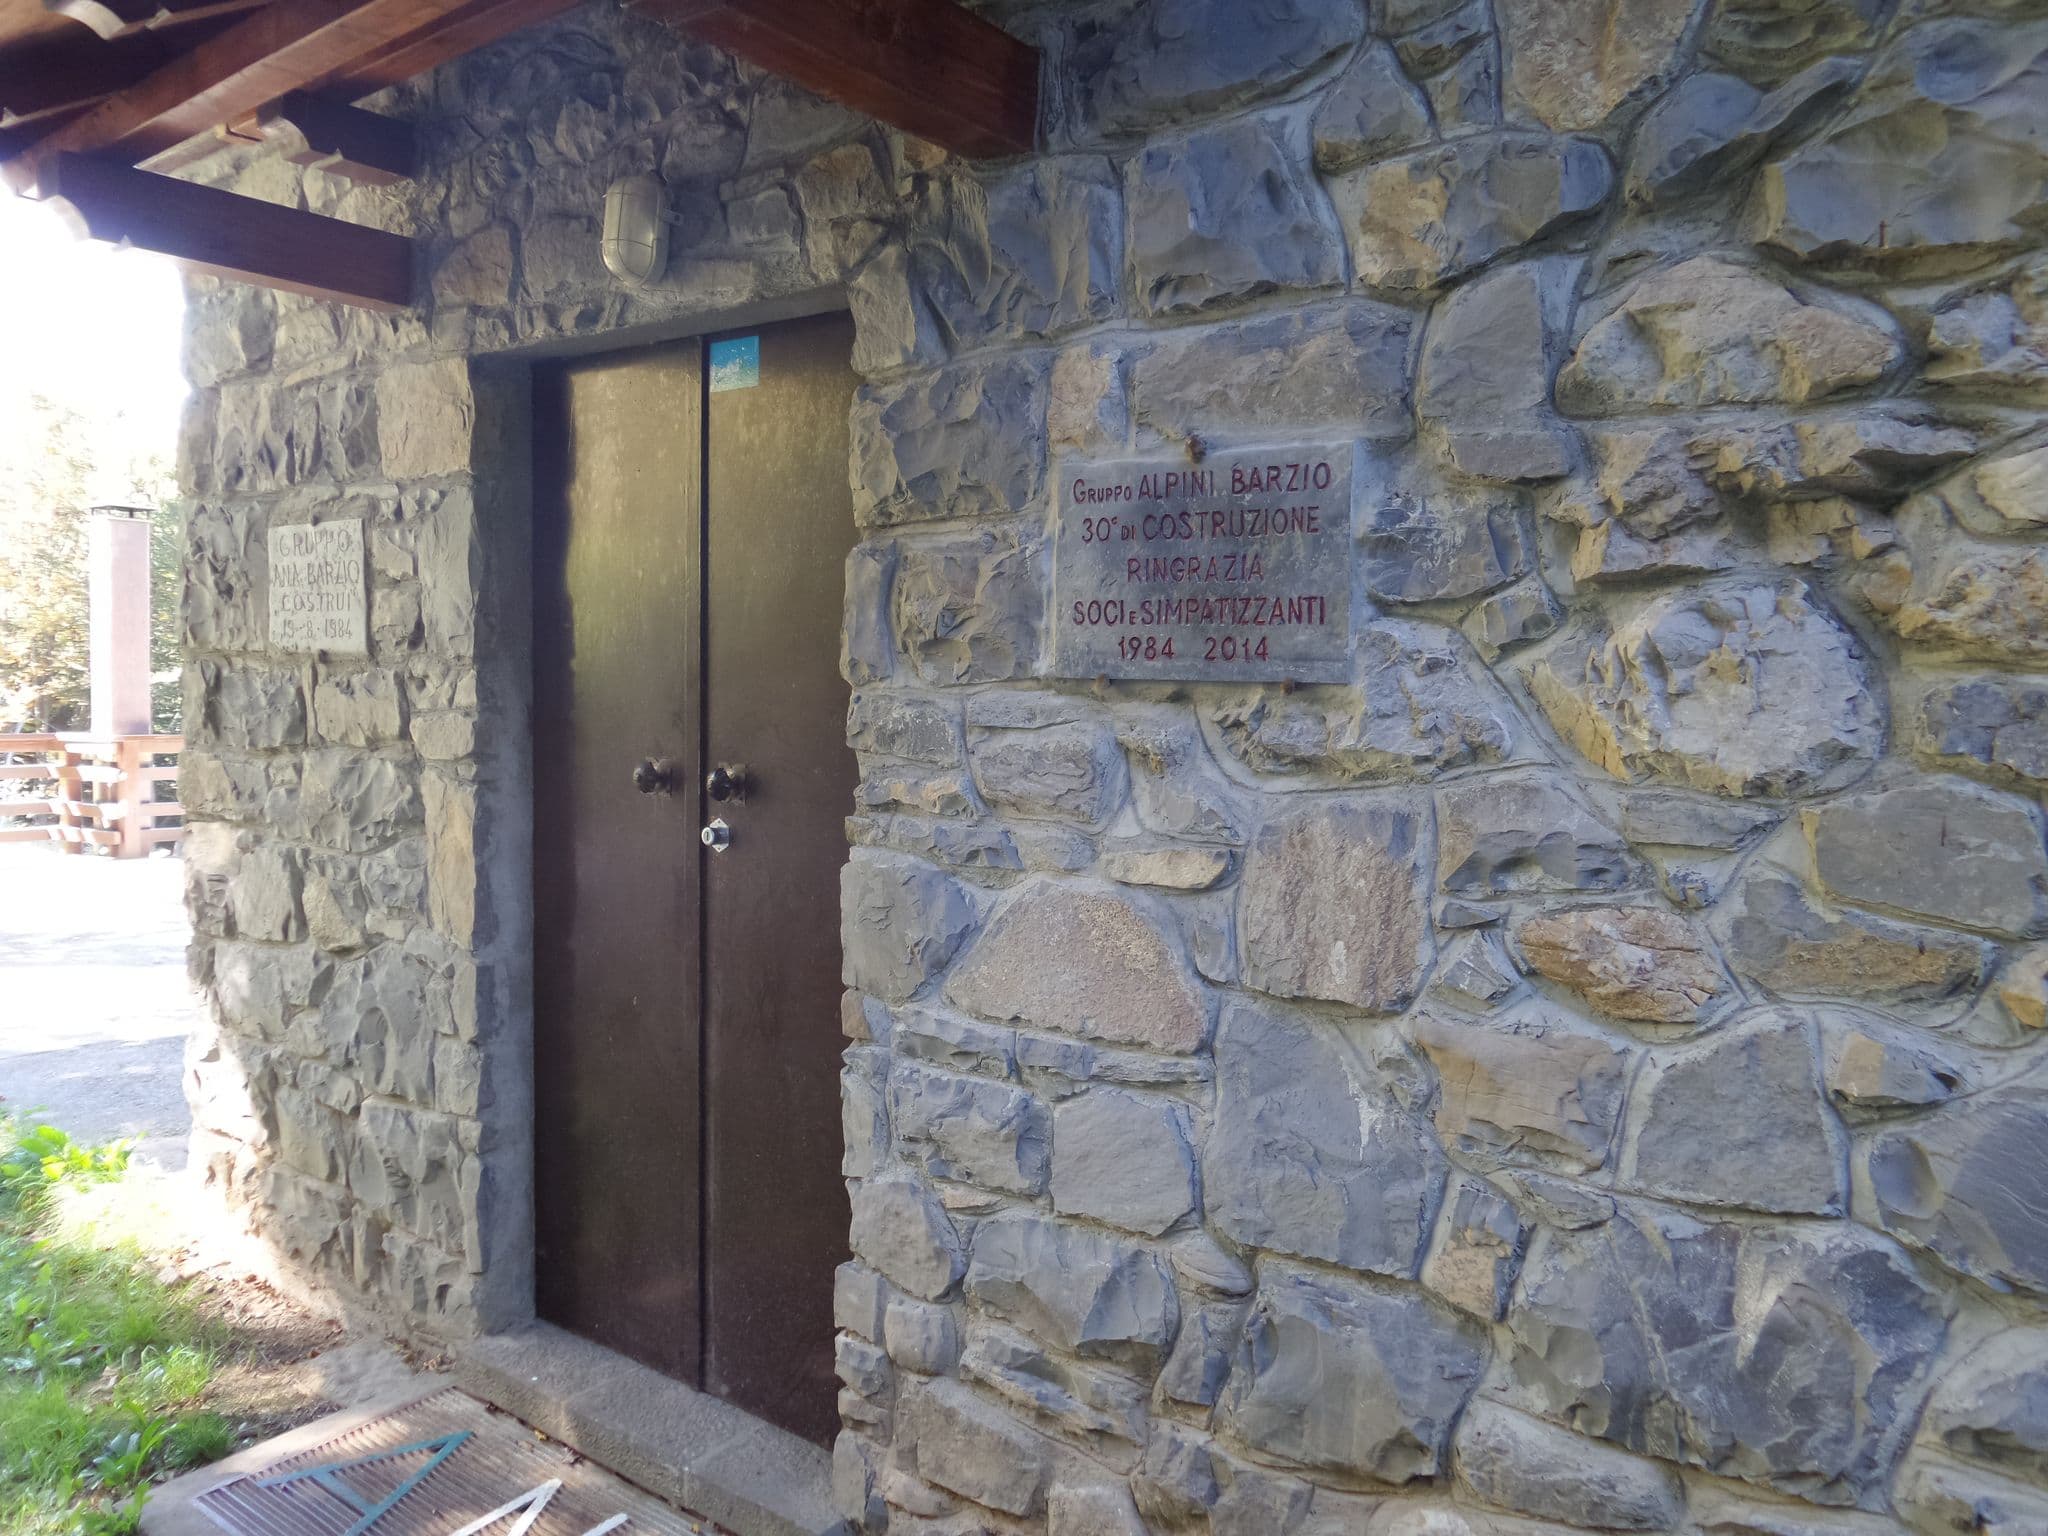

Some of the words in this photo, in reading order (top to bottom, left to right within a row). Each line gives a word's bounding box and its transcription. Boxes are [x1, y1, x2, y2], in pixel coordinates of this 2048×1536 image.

[1138, 470, 1216, 501] ALPINI
[1231, 461, 1331, 496] BARZIO
[1081, 515, 1119, 545] 30°
[1142, 505, 1321, 541] COSTRUZIONE
[279, 529, 351, 557] GRUPPO
[307, 560, 360, 586] BARZIO
[1127, 556, 1265, 584] RINGRAZIA
[1072, 599, 1125, 626] SOCI
[1141, 595, 1326, 626] SIMPATIZZANTI
[1118, 635, 1175, 661] 1984
[1203, 635, 1270, 662] 2014
